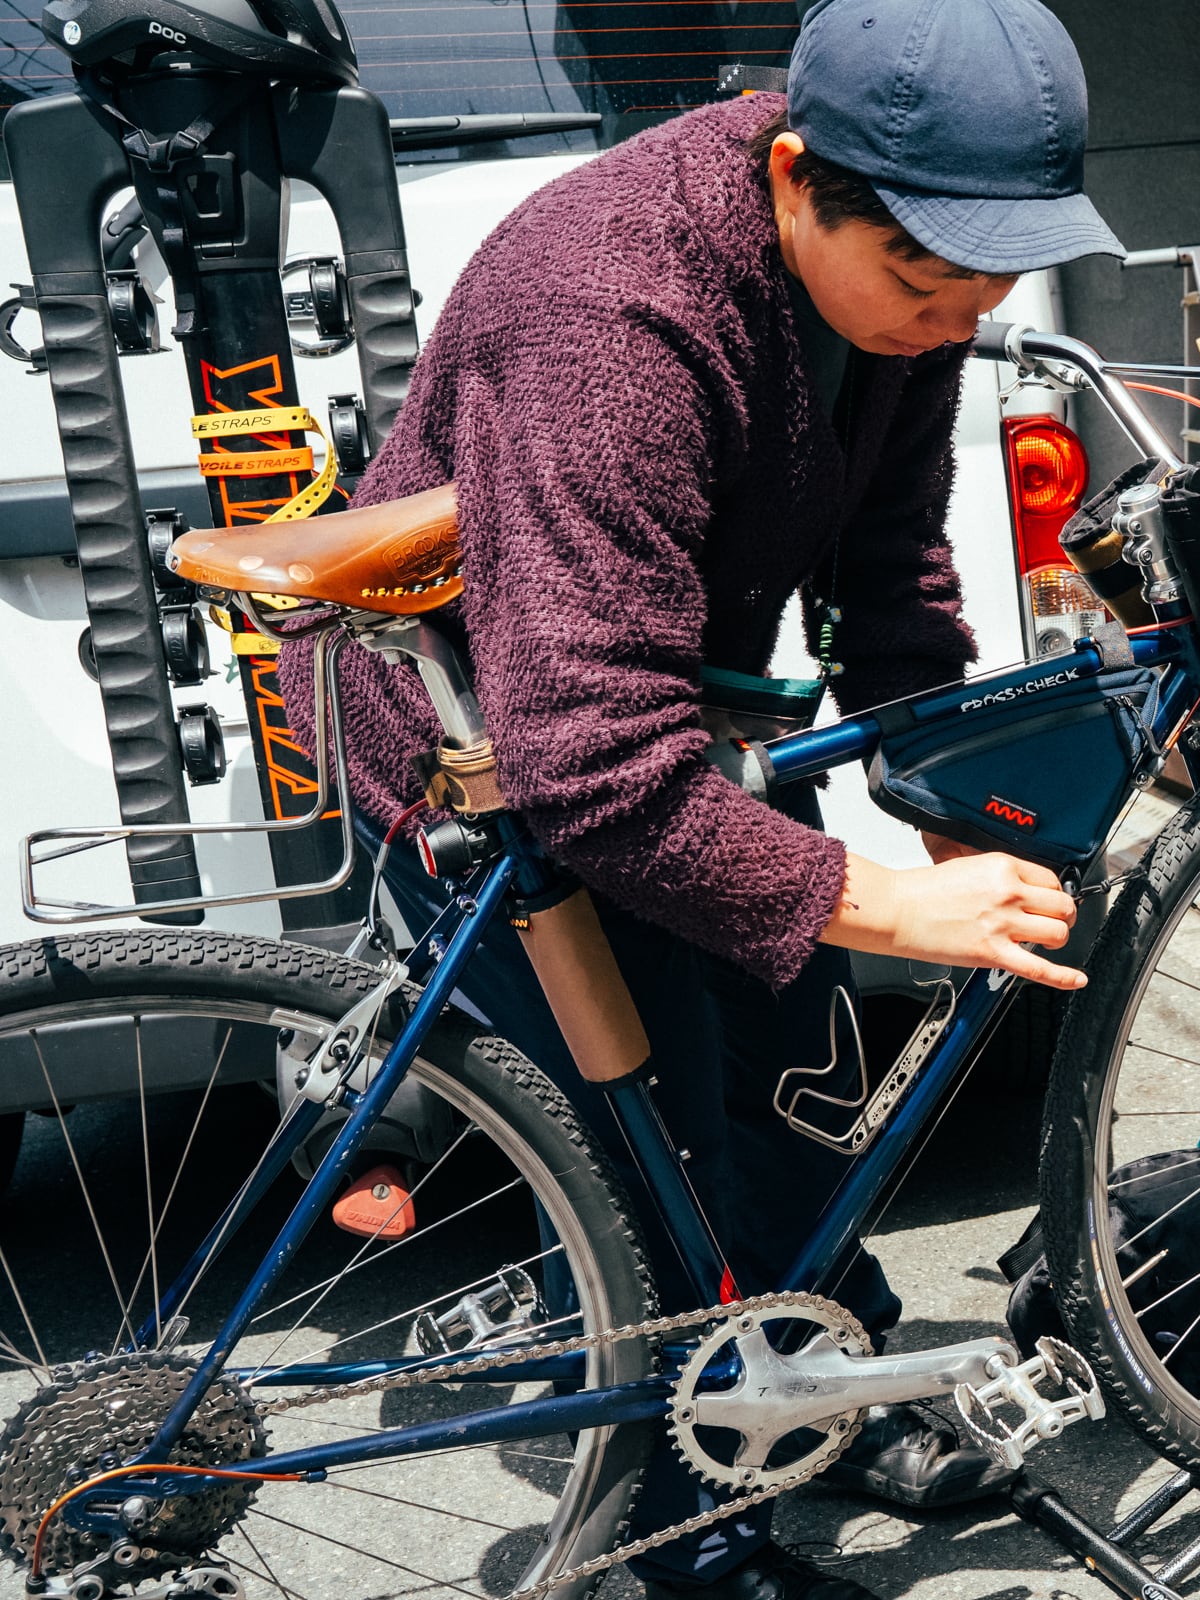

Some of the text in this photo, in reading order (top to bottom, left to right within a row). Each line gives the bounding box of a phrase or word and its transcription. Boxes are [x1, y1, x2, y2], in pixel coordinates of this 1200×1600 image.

[211, 415, 272, 431] STRAPS
[246, 456, 301, 470] STRAPS
[390, 525, 461, 568] BROOKS
